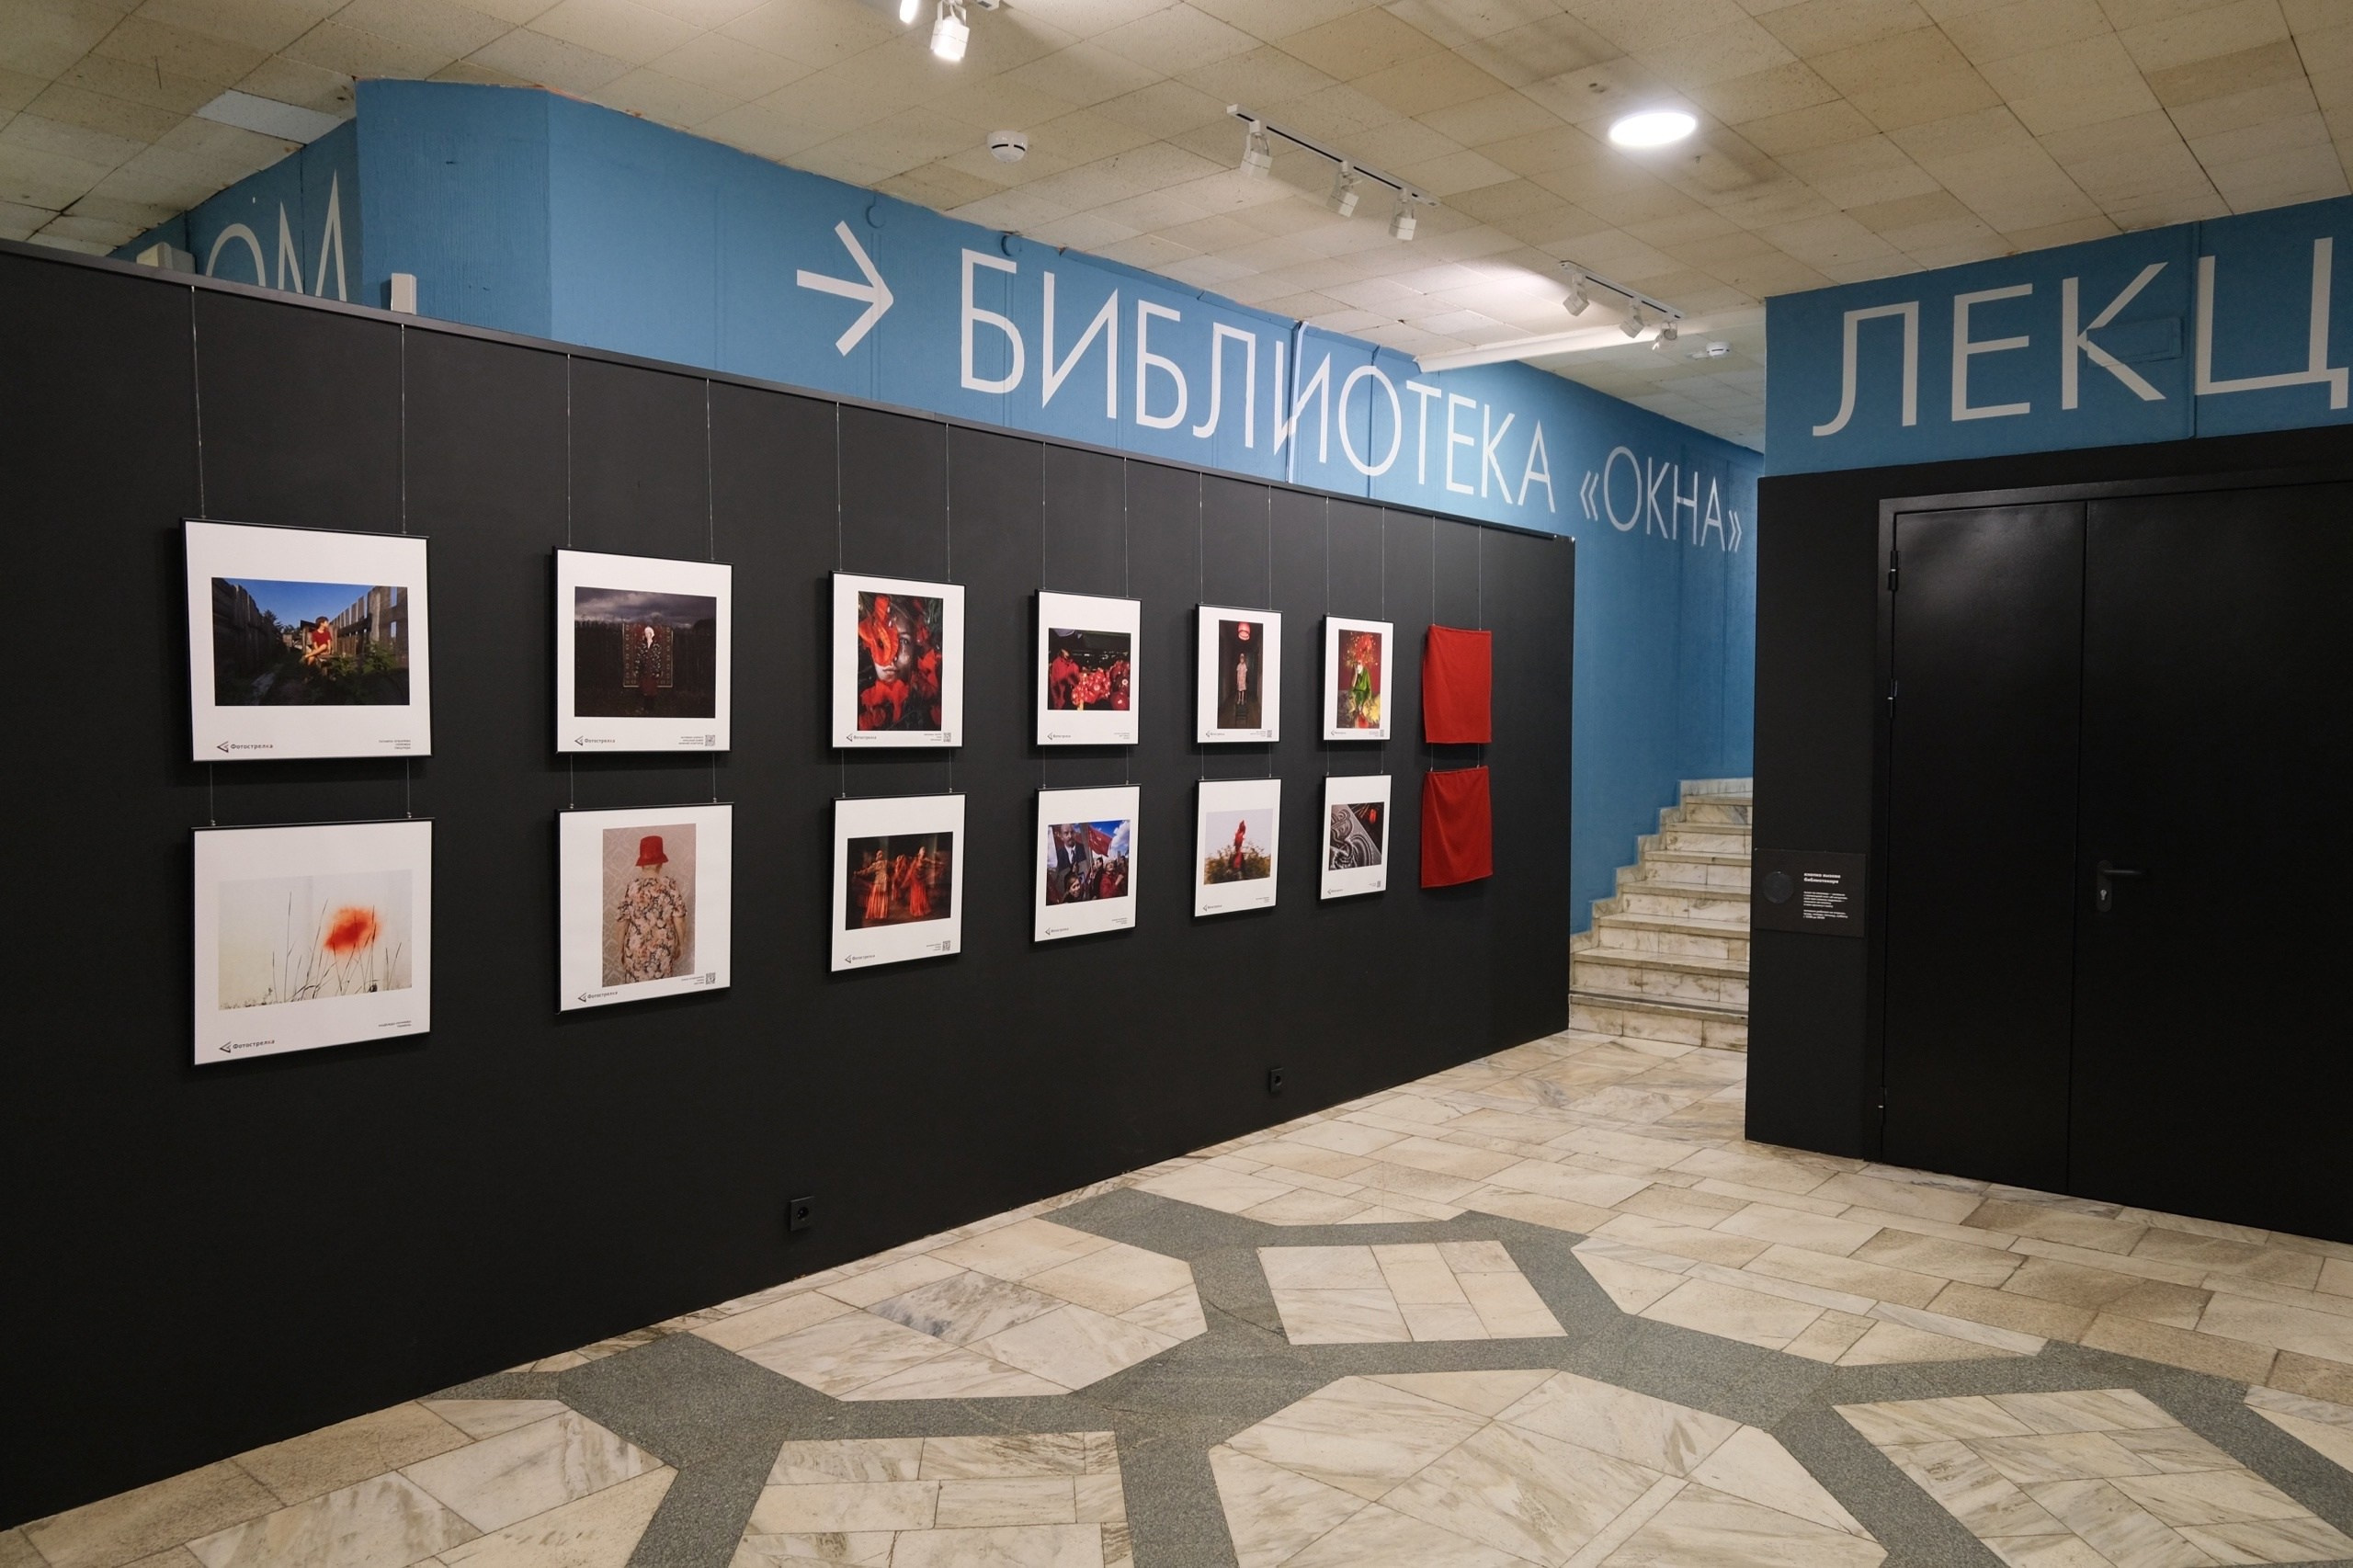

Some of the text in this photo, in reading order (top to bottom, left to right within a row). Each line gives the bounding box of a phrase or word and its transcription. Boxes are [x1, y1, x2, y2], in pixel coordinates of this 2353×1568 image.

[960, 247, 1744, 553] БИБЛИОТЕКА «ОКНА»
[1812, 236, 2349, 437] ЛЕКЦ
[233, 1040, 276, 1050] Фотострелка
